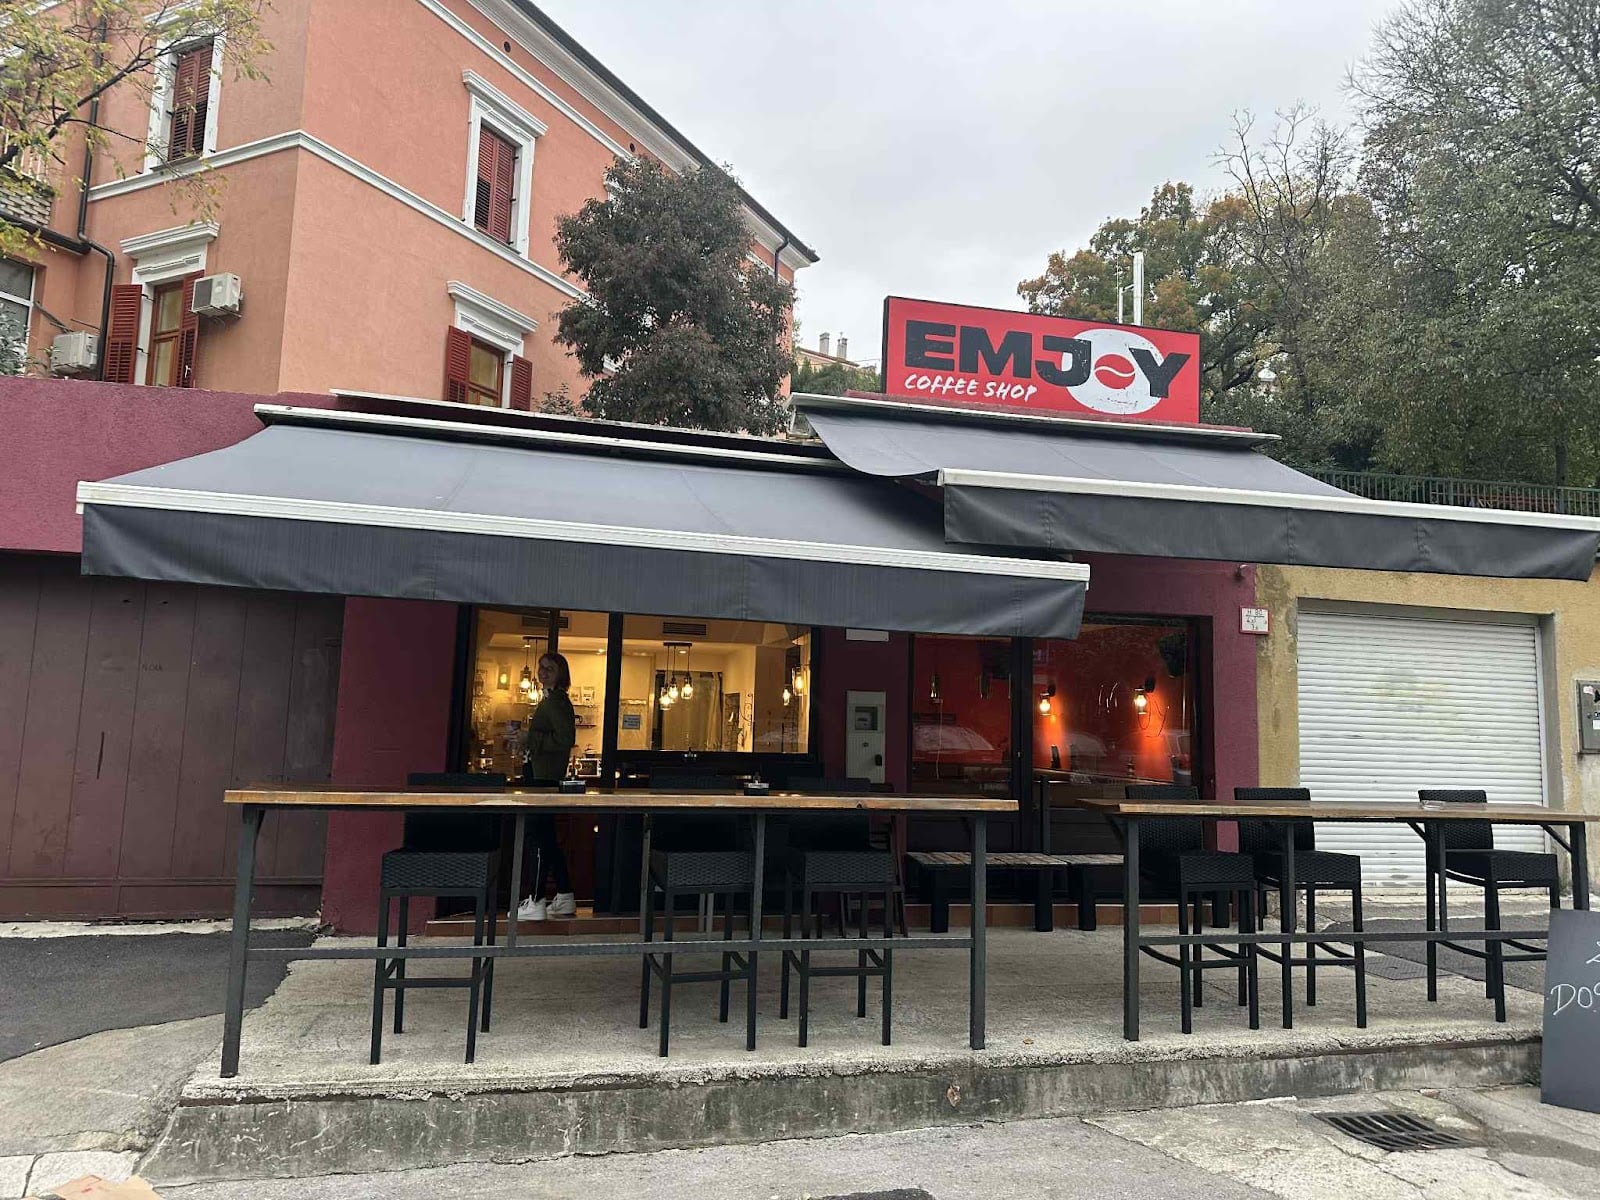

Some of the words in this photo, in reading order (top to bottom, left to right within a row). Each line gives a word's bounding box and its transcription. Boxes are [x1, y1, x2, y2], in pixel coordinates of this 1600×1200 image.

[904, 373, 979, 396] COFFEE
[983, 381, 1038, 402] SHOP
[905, 320, 1191, 414] EMJOY
